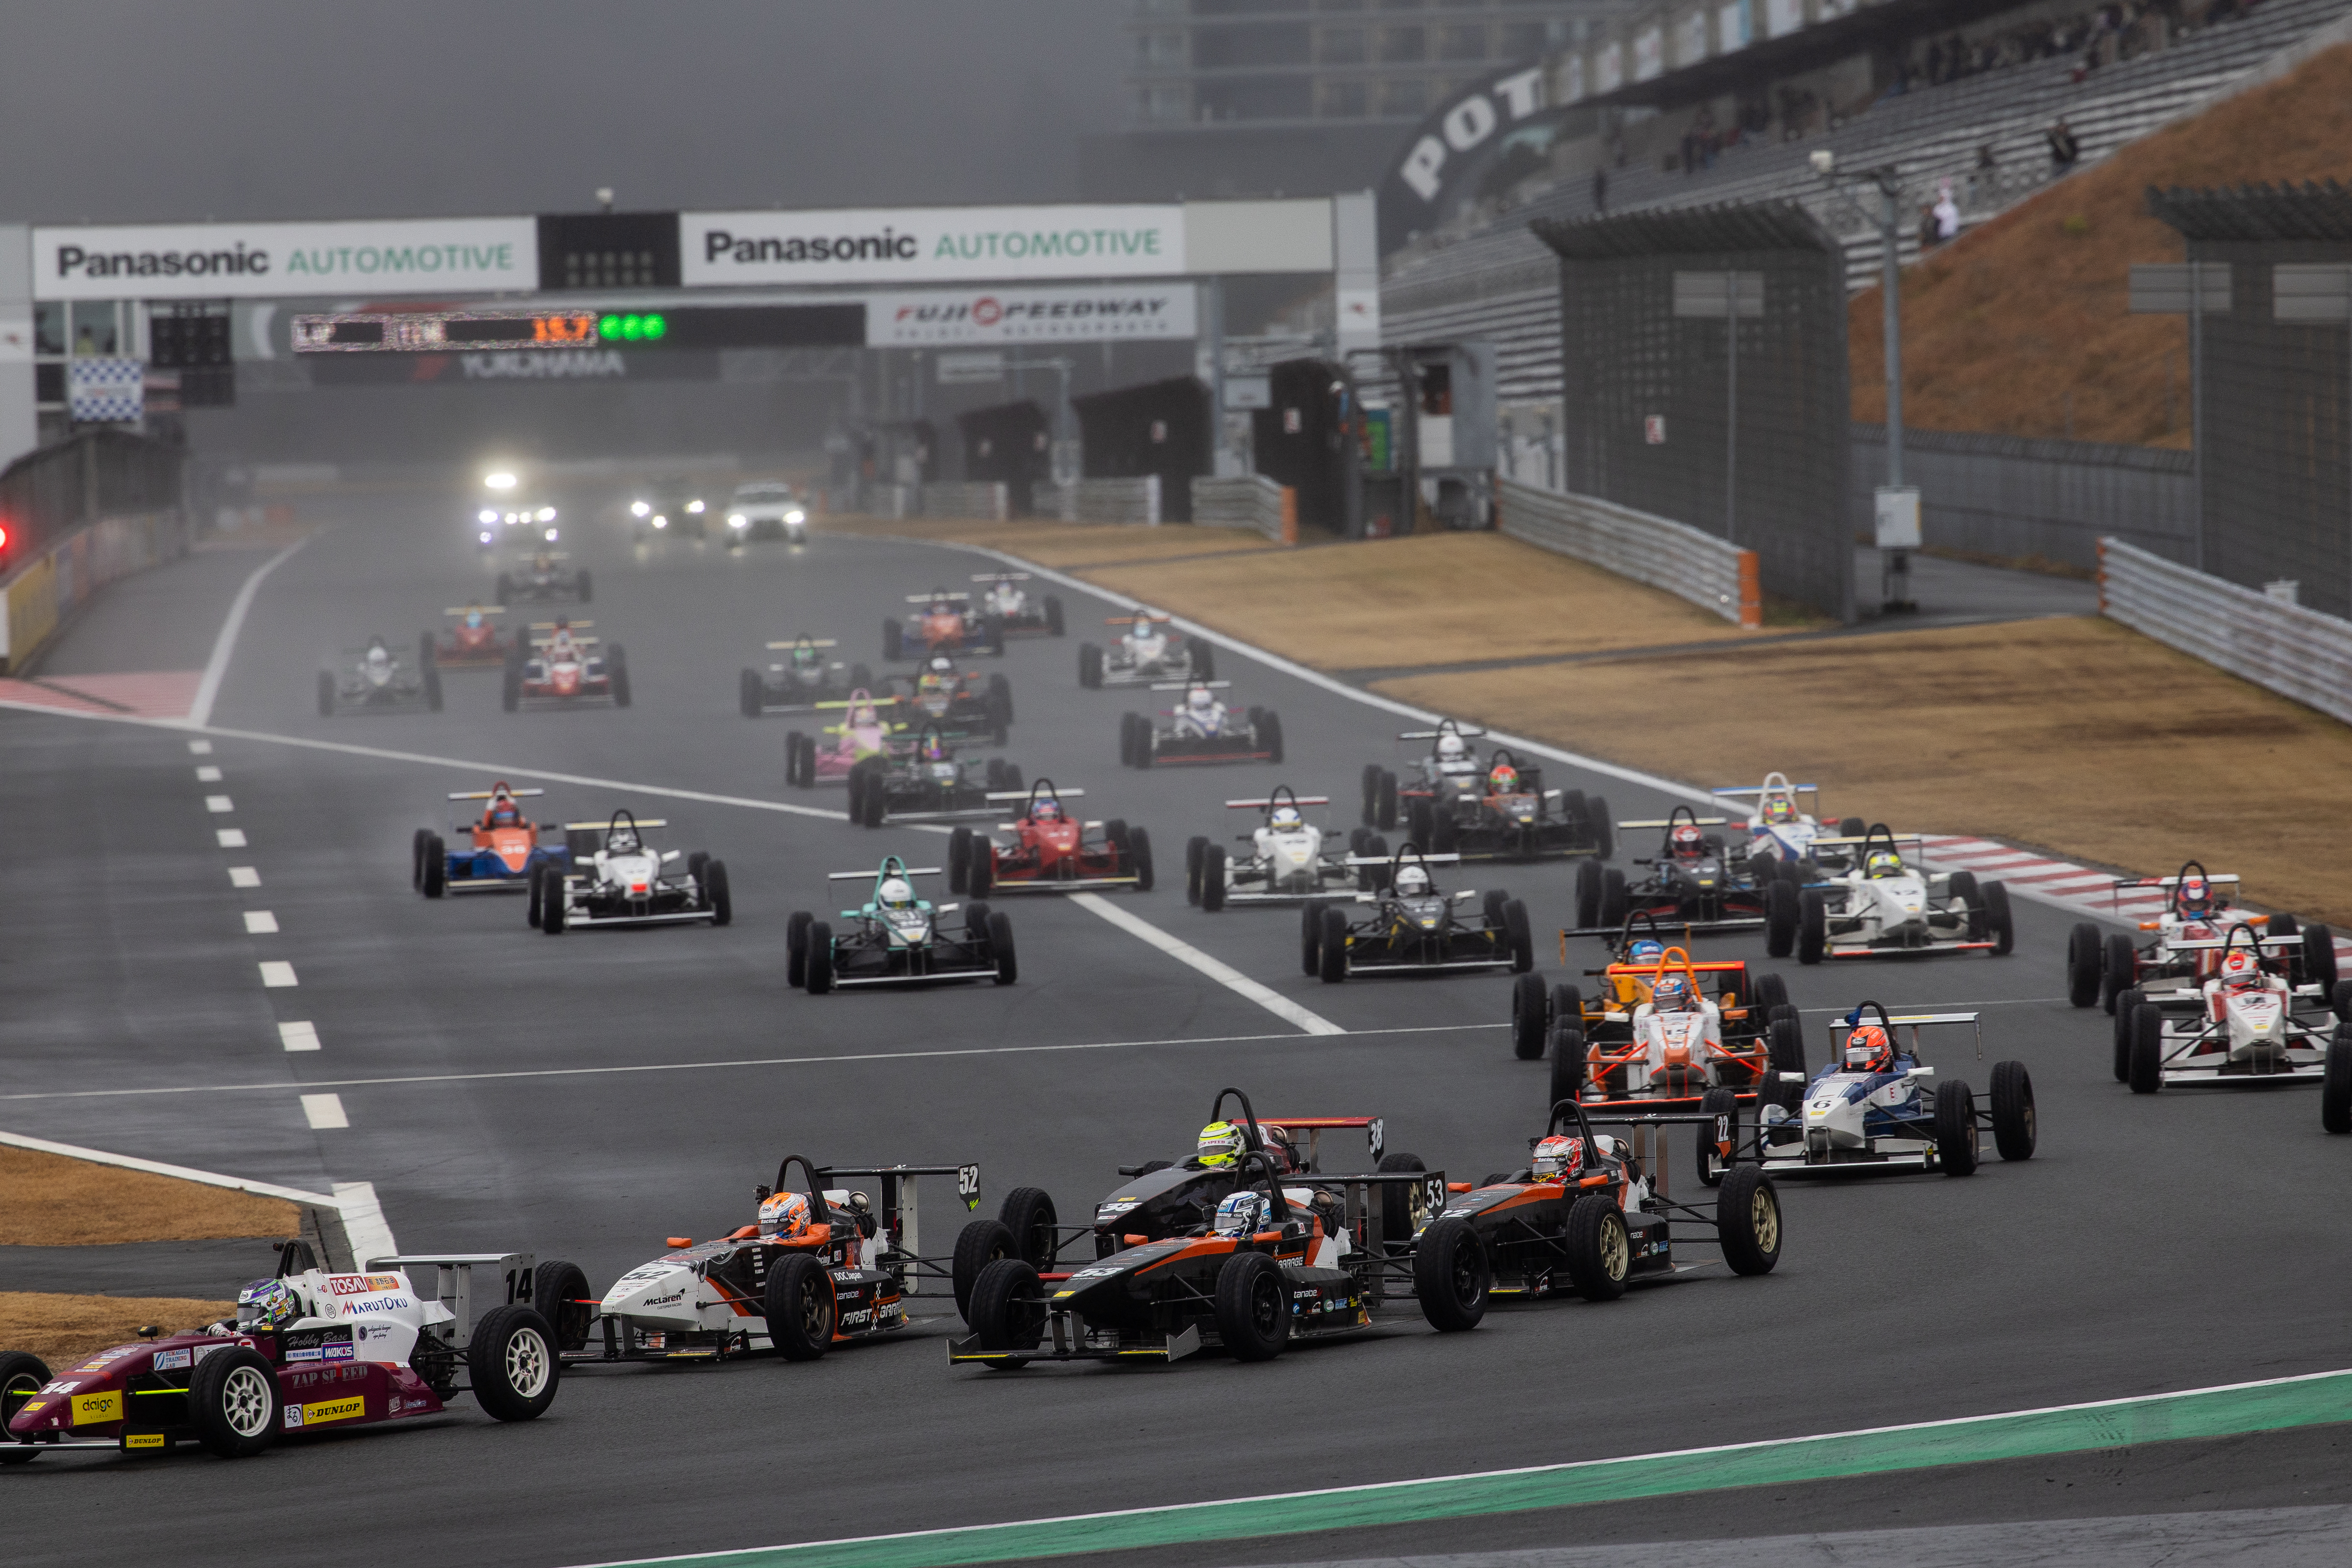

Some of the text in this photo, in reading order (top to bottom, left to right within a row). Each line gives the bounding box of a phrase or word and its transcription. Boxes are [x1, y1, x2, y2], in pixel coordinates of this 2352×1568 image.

[705, 228, 1161, 264] Panasonic AUTOMOTIVE
[57, 241, 513, 280] Panasonic AUTOMOTIVE
[460, 350, 625, 379] YOKOHAMA
[1813, 1100, 1832, 1108] 6
[1718, 1115, 1728, 1142] 22
[1370, 1119, 1383, 1154] 38
[959, 1166, 978, 1194] 52
[1427, 1179, 1443, 1208] 53
[1099, 1202, 1142, 1212] 38
[1278, 1257, 1303, 1268] GARAGE
[621, 1271, 671, 1280] 52
[834, 1272, 863, 1281] DOC Japan
[1072, 1267, 1124, 1277] 53
[506, 1268, 533, 1305] 14
[643, 1295, 681, 1306] McLaren
[841, 1308, 872, 1326] FIRST
[287, 1332, 347, 1347] Hobby Base
[293, 1372, 318, 1388] ZAP
[40, 1381, 82, 1395] 14
[82, 1398, 113, 1412] daigo
[316, 1403, 360, 1417] DUNLOP
